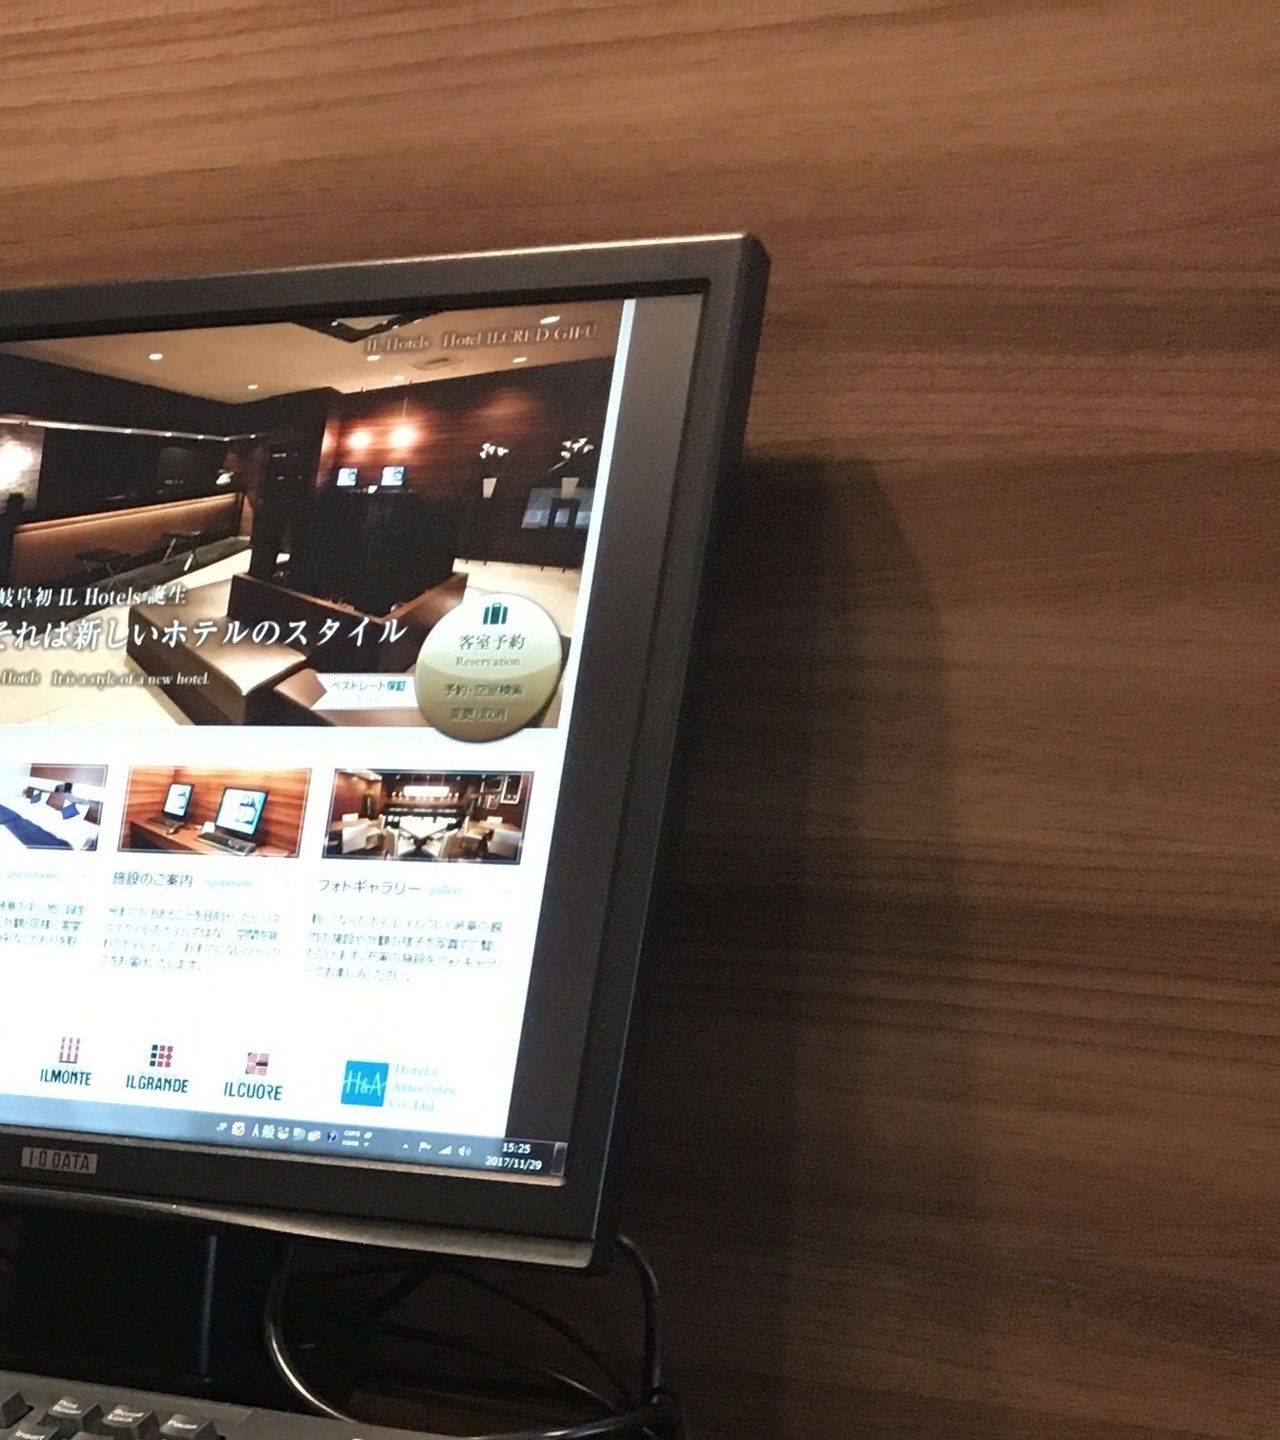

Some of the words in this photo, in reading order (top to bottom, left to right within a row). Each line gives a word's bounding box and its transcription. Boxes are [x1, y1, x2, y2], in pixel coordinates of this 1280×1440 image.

[459, 633, 525, 650] 客室予約
[113, 871, 194, 888] 施設のご案内
[318, 878, 421, 895] フォトギャラリー
[40, 1068, 92, 1087] ILMONTE
[126, 1073, 189, 1094] ILGRANDE
[223, 1080, 283, 1102] ILCUORE
[502, 1141, 532, 1154] 15:25
[51, 1151, 90, 1172] DATA
[485, 1155, 543, 1171] 2017/11/29
